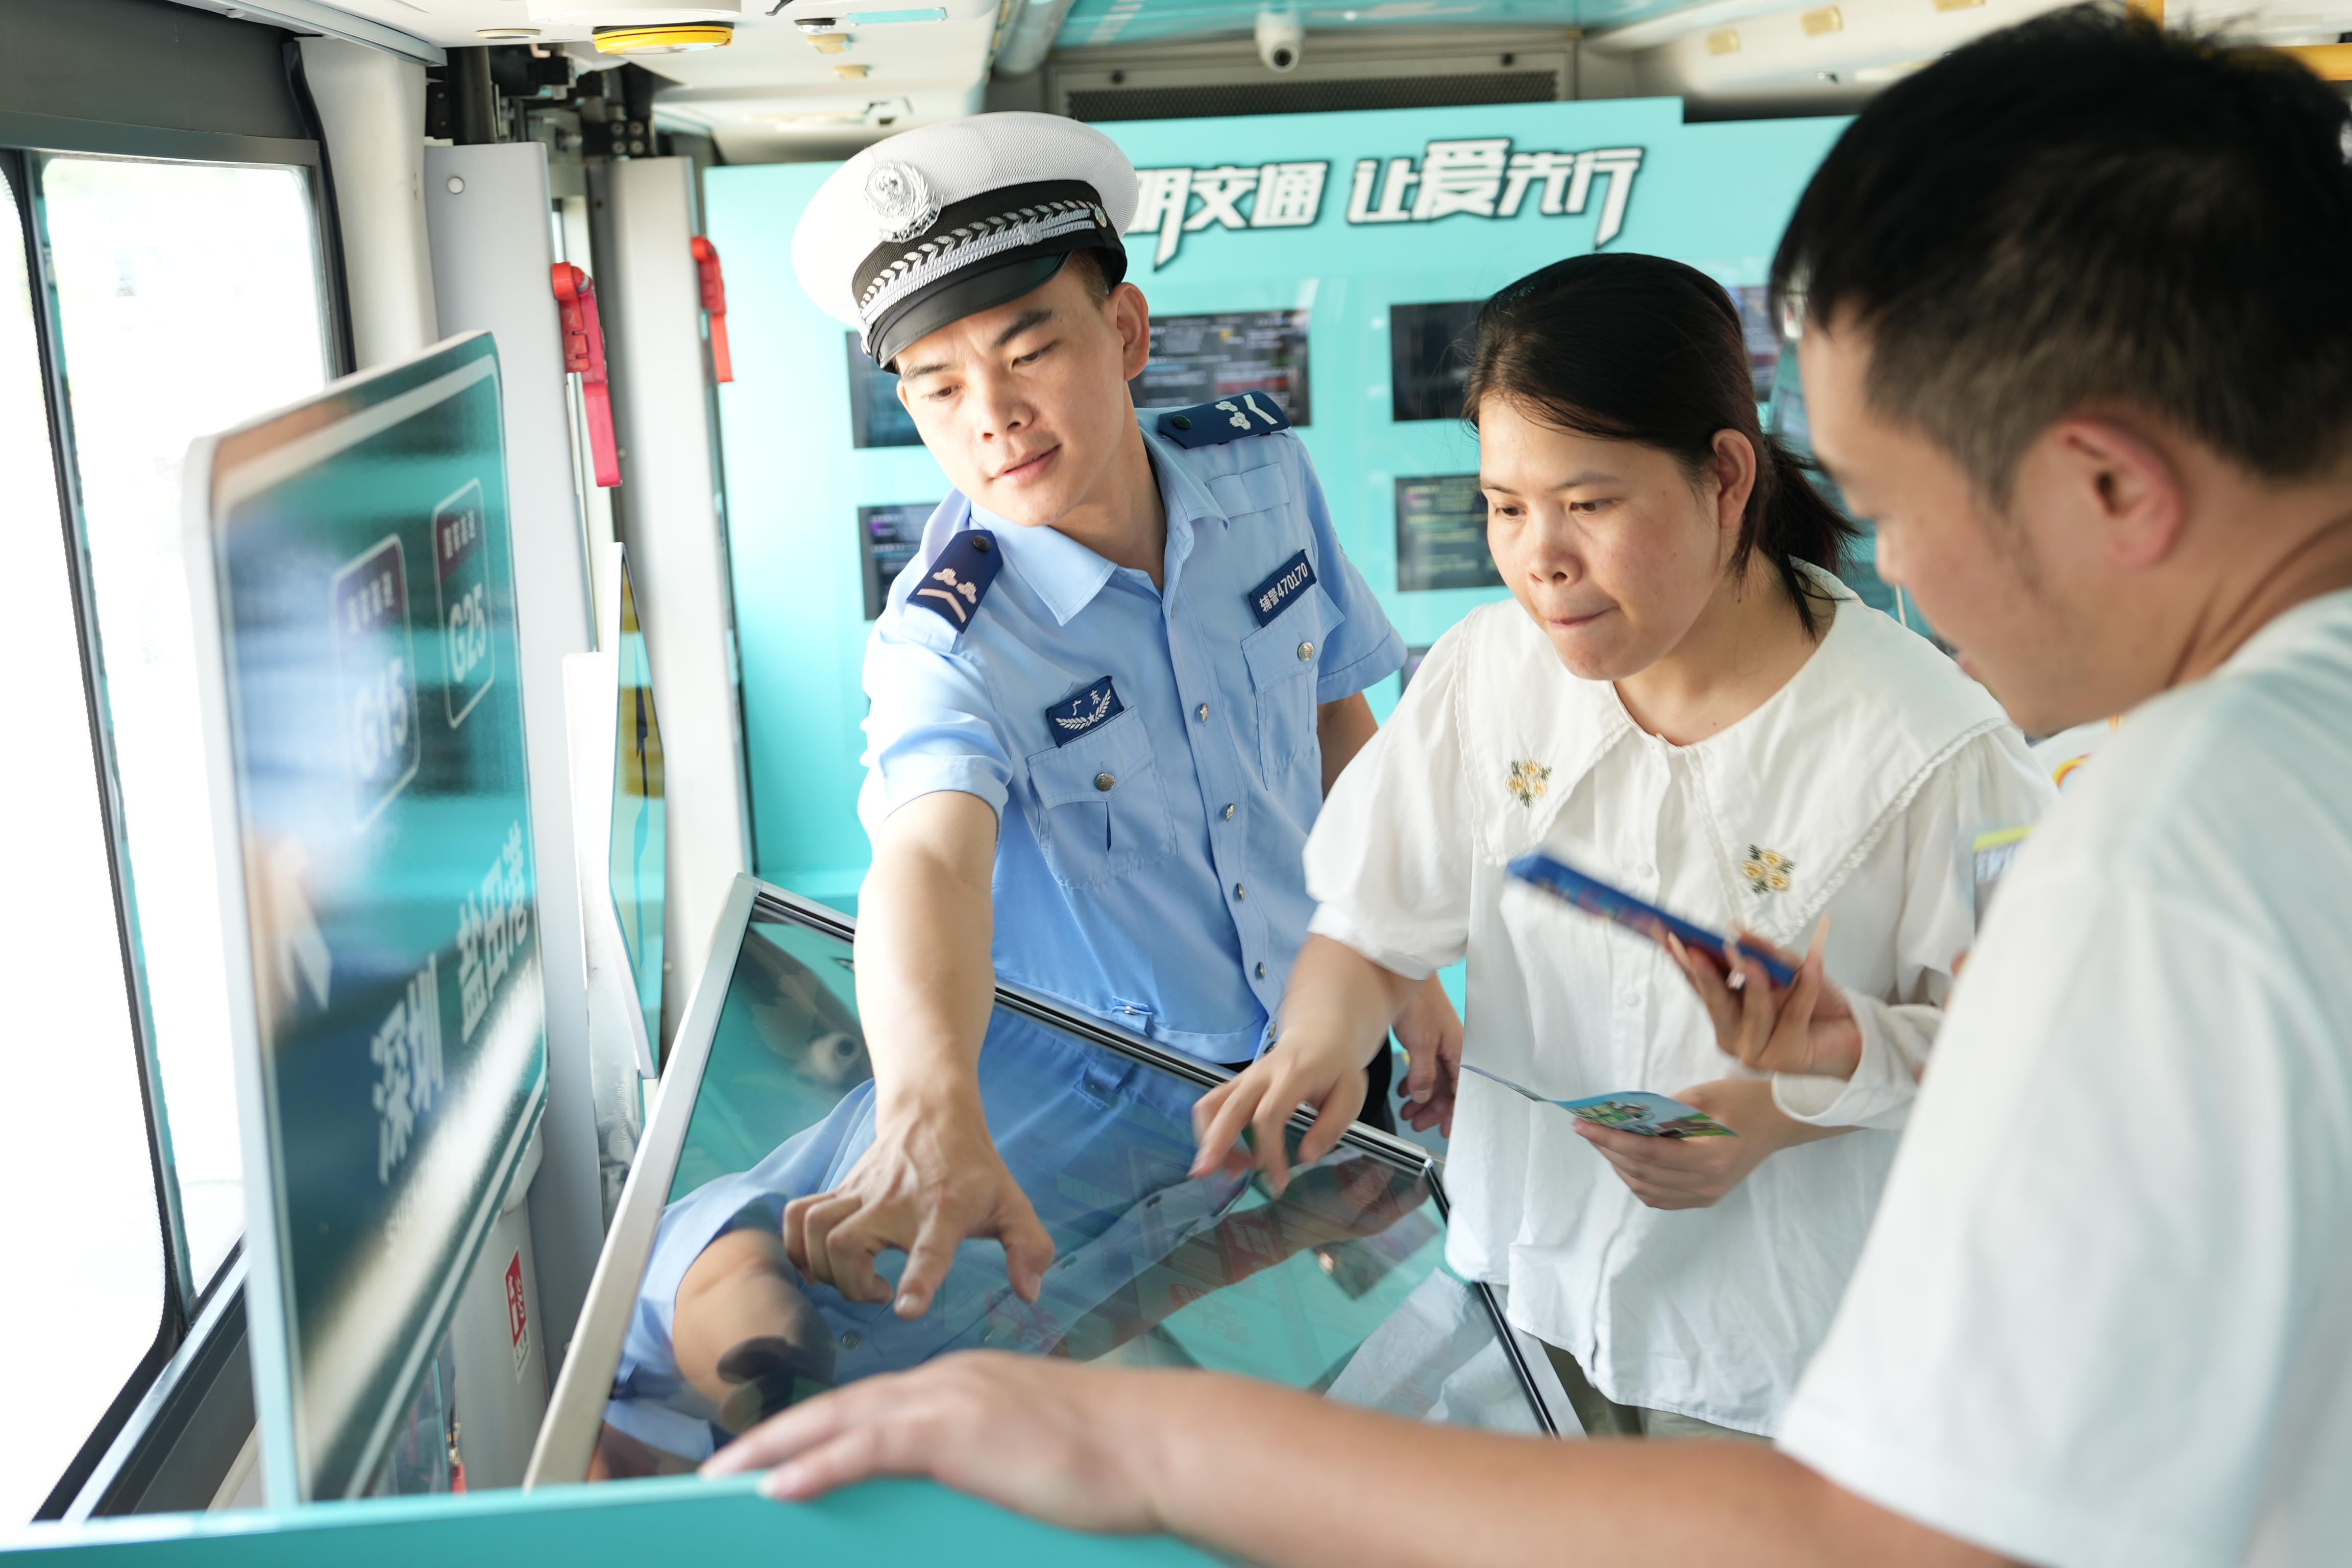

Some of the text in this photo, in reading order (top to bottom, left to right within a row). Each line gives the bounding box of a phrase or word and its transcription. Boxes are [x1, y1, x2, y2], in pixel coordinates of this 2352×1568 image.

[1346, 138, 1645, 250] 让爱先行
[448, 581, 486, 683] G25
[1259, 562, 1308, 613] 辅警470170
[353, 655, 409, 779] G15
[456, 819, 528, 1044] 盐田港
[370, 951, 445, 1185] 深圳
